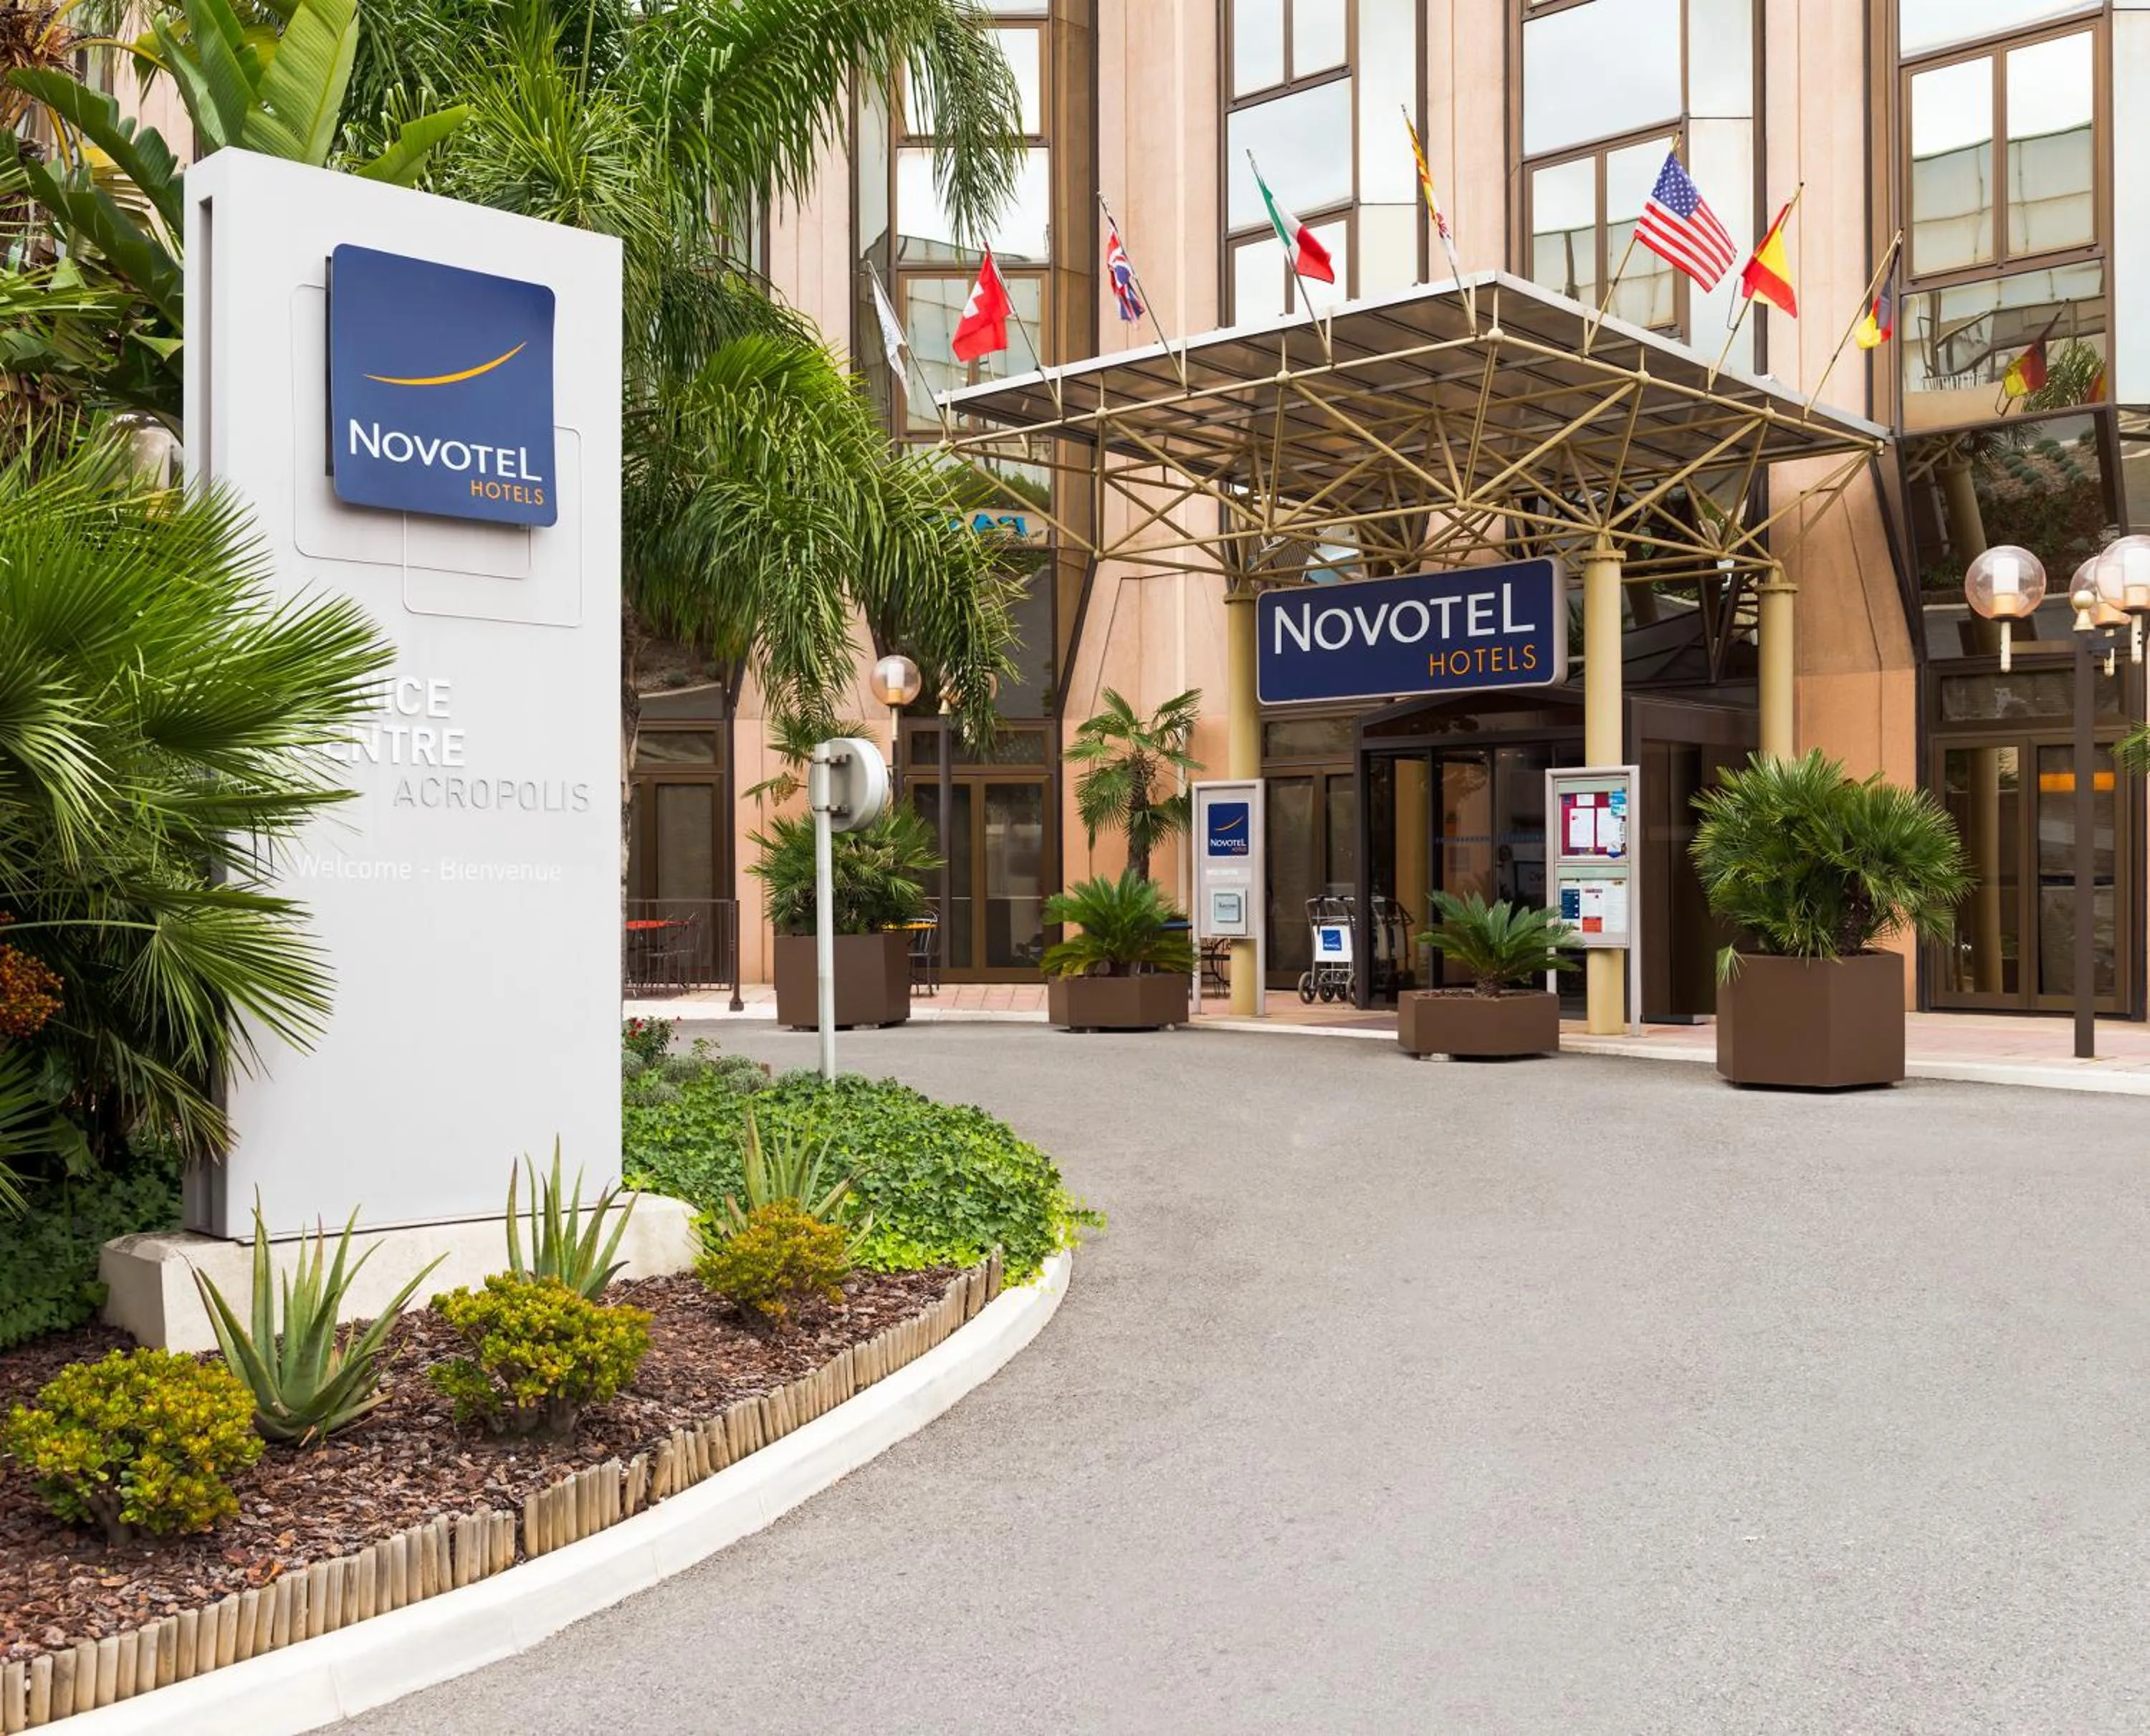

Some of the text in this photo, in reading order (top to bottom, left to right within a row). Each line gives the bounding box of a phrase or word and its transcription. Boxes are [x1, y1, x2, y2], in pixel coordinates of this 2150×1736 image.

[350, 419, 543, 482] NOVOTEL
[471, 480, 545, 505] HOTELS
[1274, 583, 1535, 654] NOVOTEL
[1429, 644, 1537, 677] HOTELS
[393, 776, 591, 813] ACROPOLIS
[1210, 838, 1246, 847] NOVOTEL
[297, 854, 412, 880] Welcome
[440, 859, 562, 882] Bienvenue
